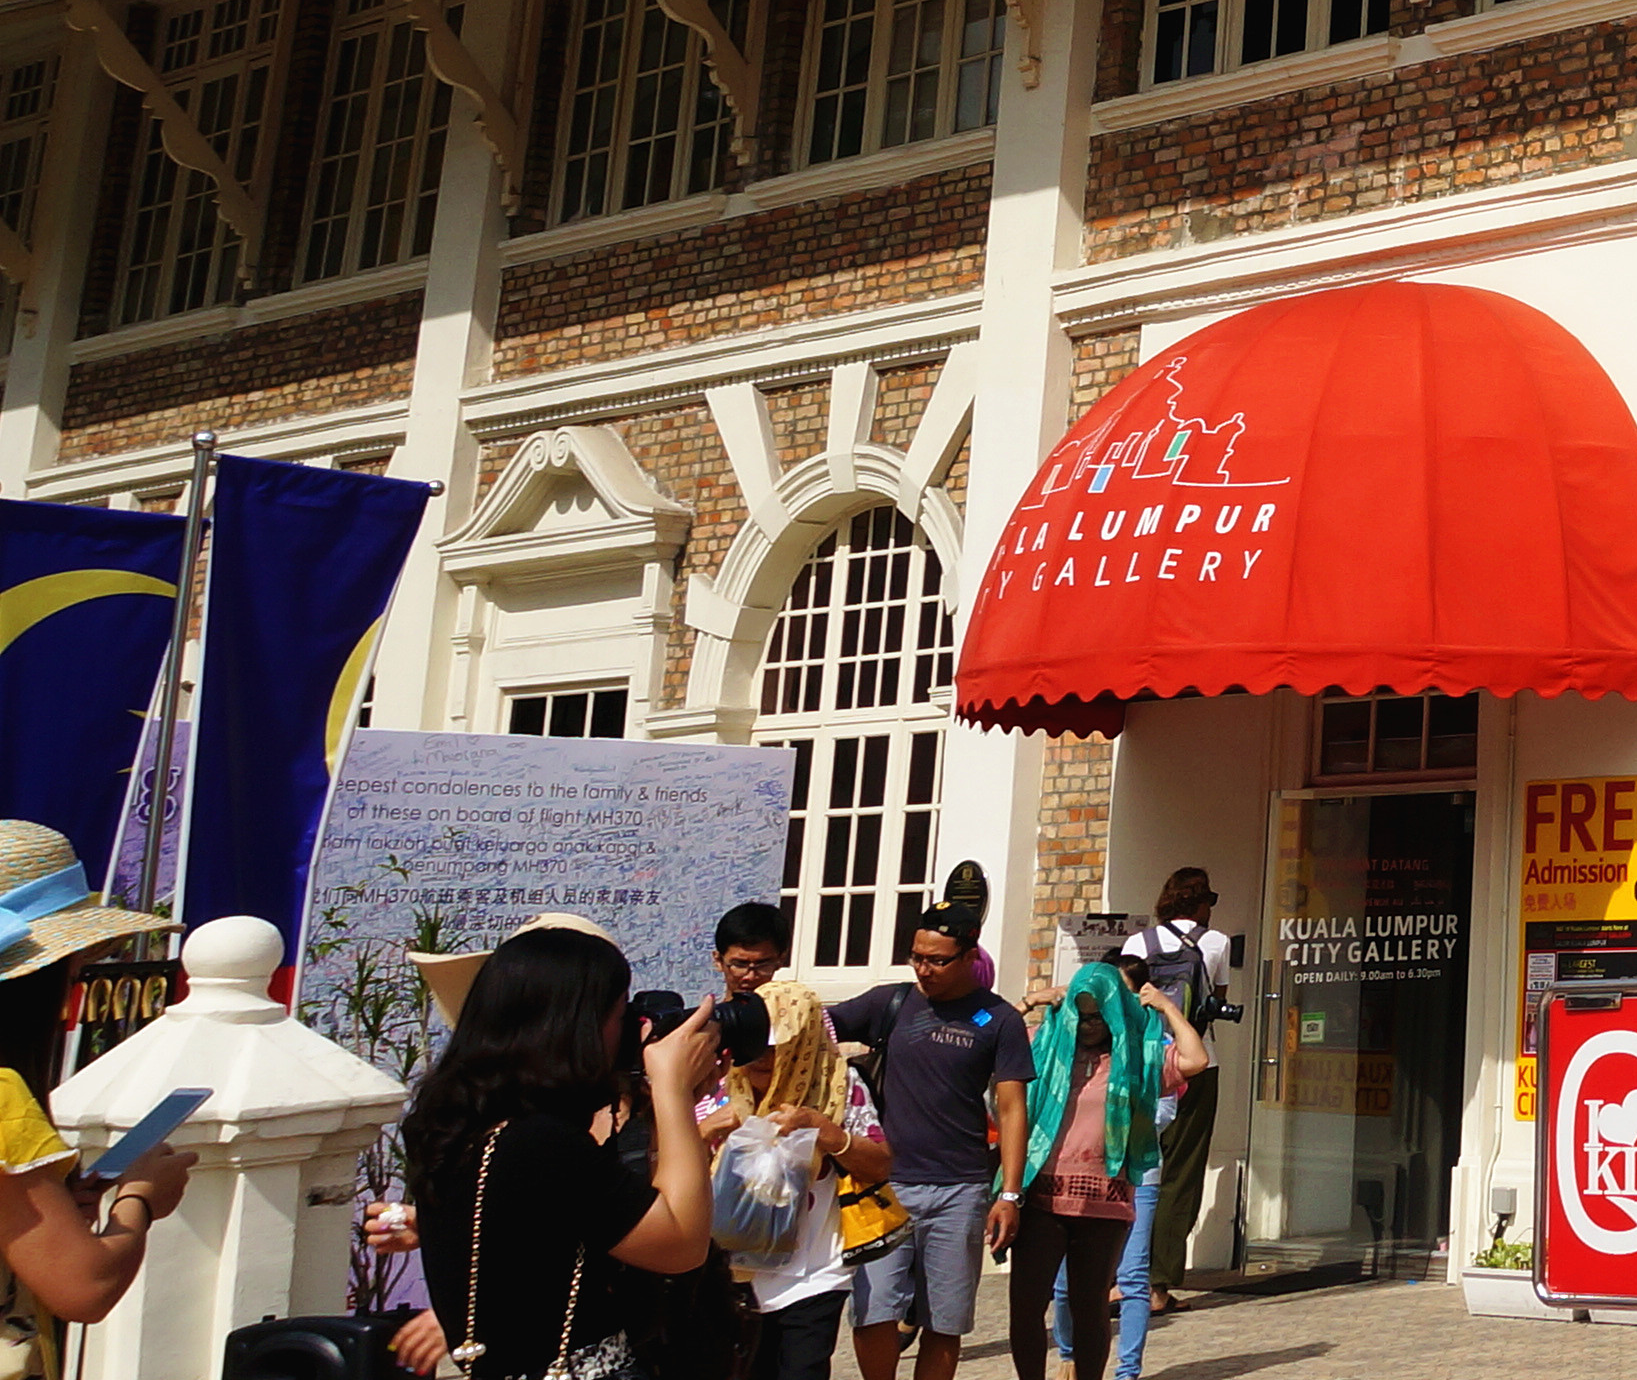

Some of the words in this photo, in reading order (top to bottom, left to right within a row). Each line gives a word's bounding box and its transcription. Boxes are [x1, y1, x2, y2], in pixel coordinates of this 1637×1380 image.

[1067, 503, 1277, 541] LUMPUR
[1031, 548, 1263, 592] GALLERY
[401, 778, 521, 798] condolences
[527, 780, 544, 798] to
[550, 782, 578, 799] the
[583, 782, 634, 803] family
[637, 786, 650, 801] &
[654, 786, 708, 804] friends
[347, 804, 367, 820] of
[372, 804, 422, 821] these
[428, 808, 451, 822] on
[456, 805, 511, 823] board
[520, 806, 537, 823] of
[540, 807, 582, 827] flight
[585, 810, 643, 826] MH370
[555, 838, 593, 854] anak
[513, 858, 568, 874] MH370
[1381, 859, 1430, 871] DATANG
[1524, 857, 1629, 885] Admission
[1279, 917, 1357, 941] KUALA
[1365, 914, 1459, 937] LUMPUR
[1284, 942, 1342, 967] CITY
[1347, 939, 1457, 964] GALLERY
[1294, 971, 1324, 985] OPEN
[1326, 970, 1359, 983] DAILY:
[1360, 969, 1394, 982] 9.00am
[1396, 969, 1406, 980] to
